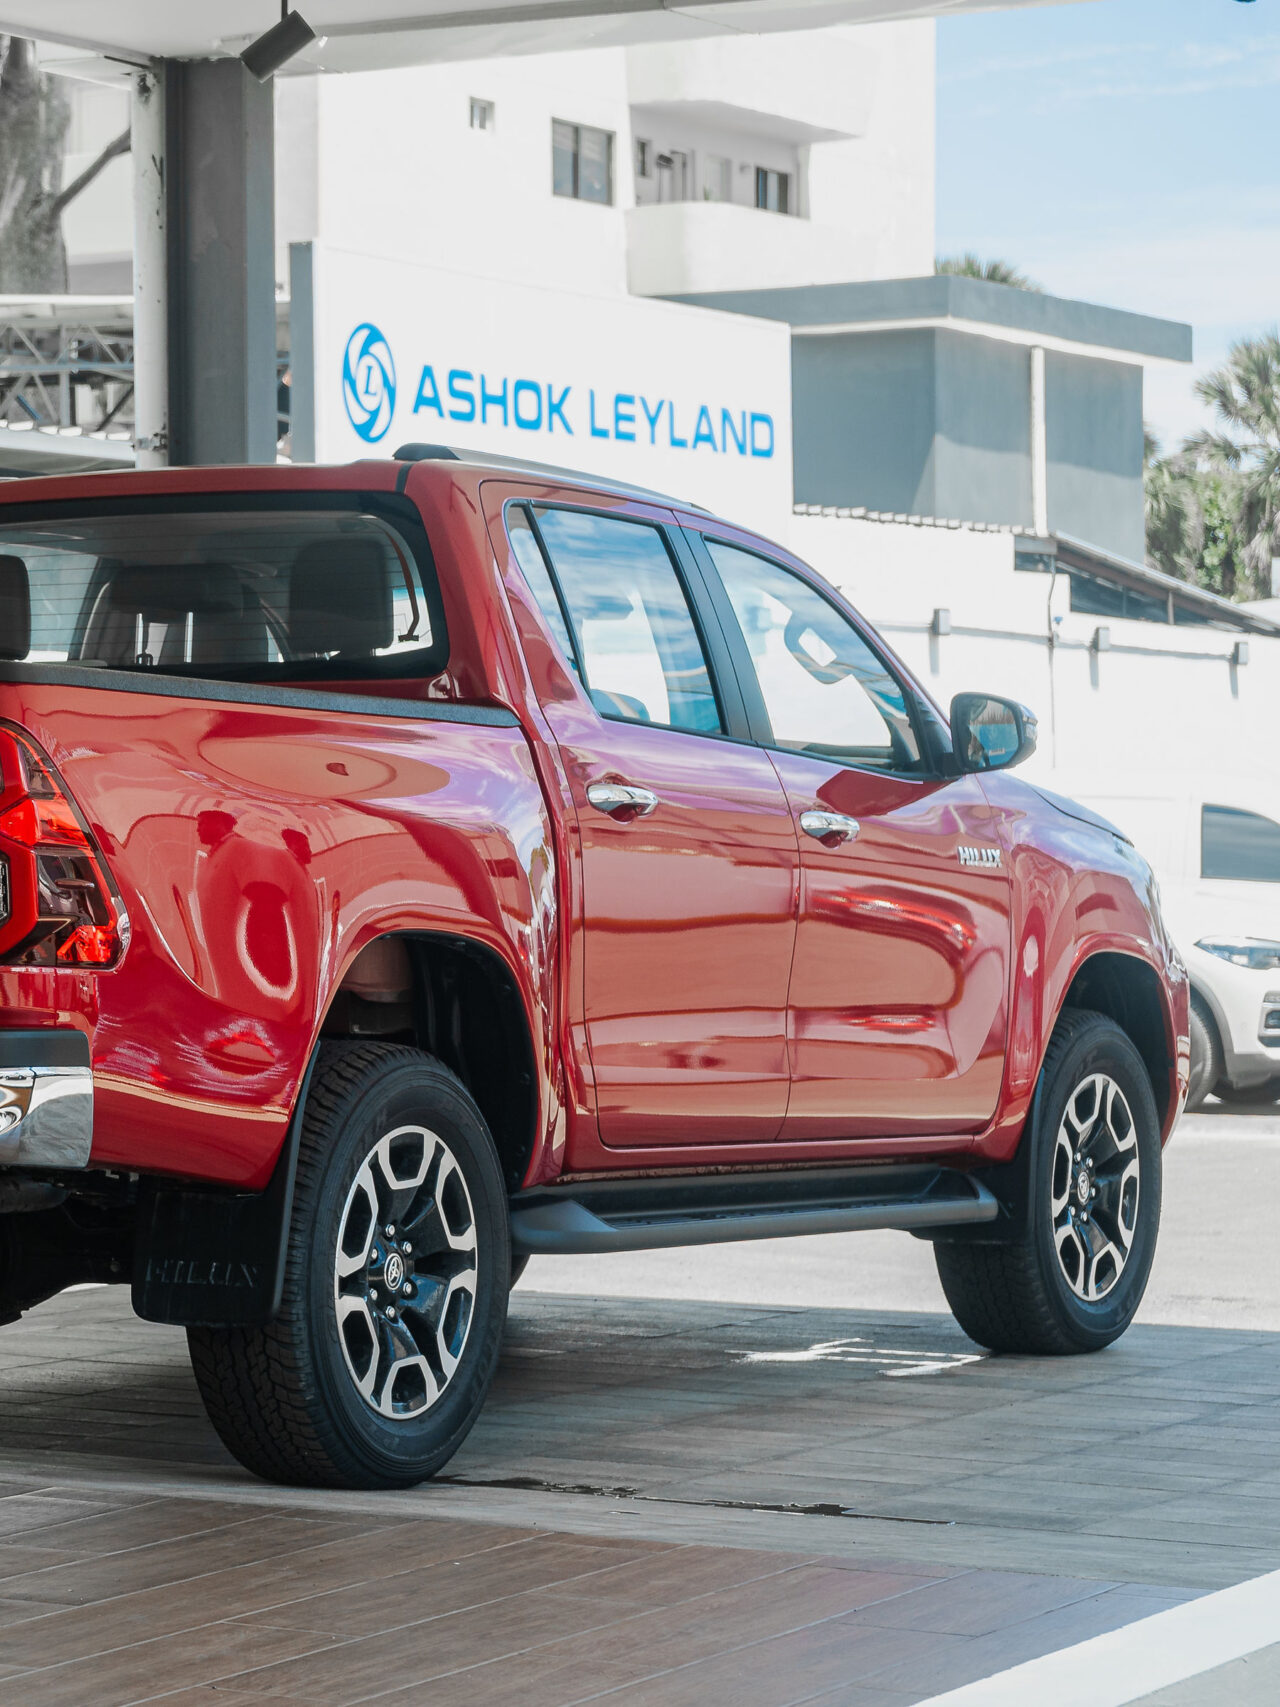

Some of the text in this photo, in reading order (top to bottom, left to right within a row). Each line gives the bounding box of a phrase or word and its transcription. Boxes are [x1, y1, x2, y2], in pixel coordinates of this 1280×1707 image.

[412, 365, 775, 459] ASHOK LEYLAND
[958, 846, 1002, 868] HILUX
